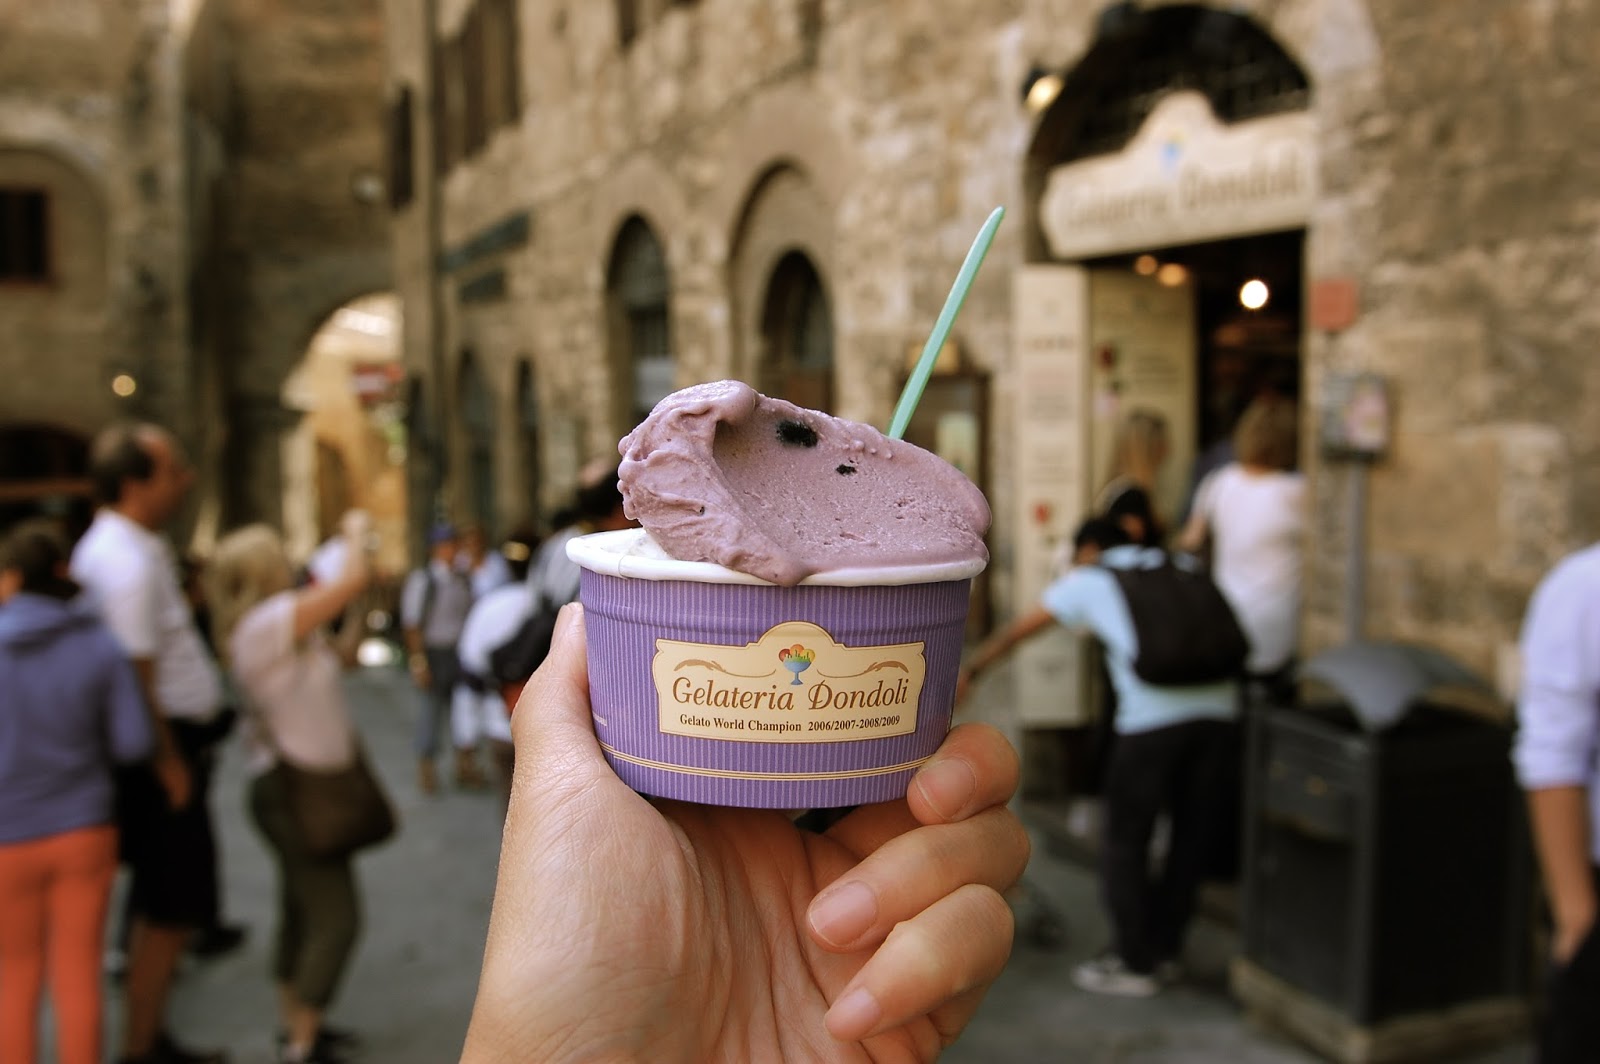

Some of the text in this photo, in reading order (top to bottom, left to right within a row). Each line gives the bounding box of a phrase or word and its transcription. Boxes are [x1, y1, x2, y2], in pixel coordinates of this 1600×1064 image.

[672, 676, 909, 711] Gelateria Dondoli
[679, 713, 901, 733] Gelato World Champion 2006/2007-2008/2009
